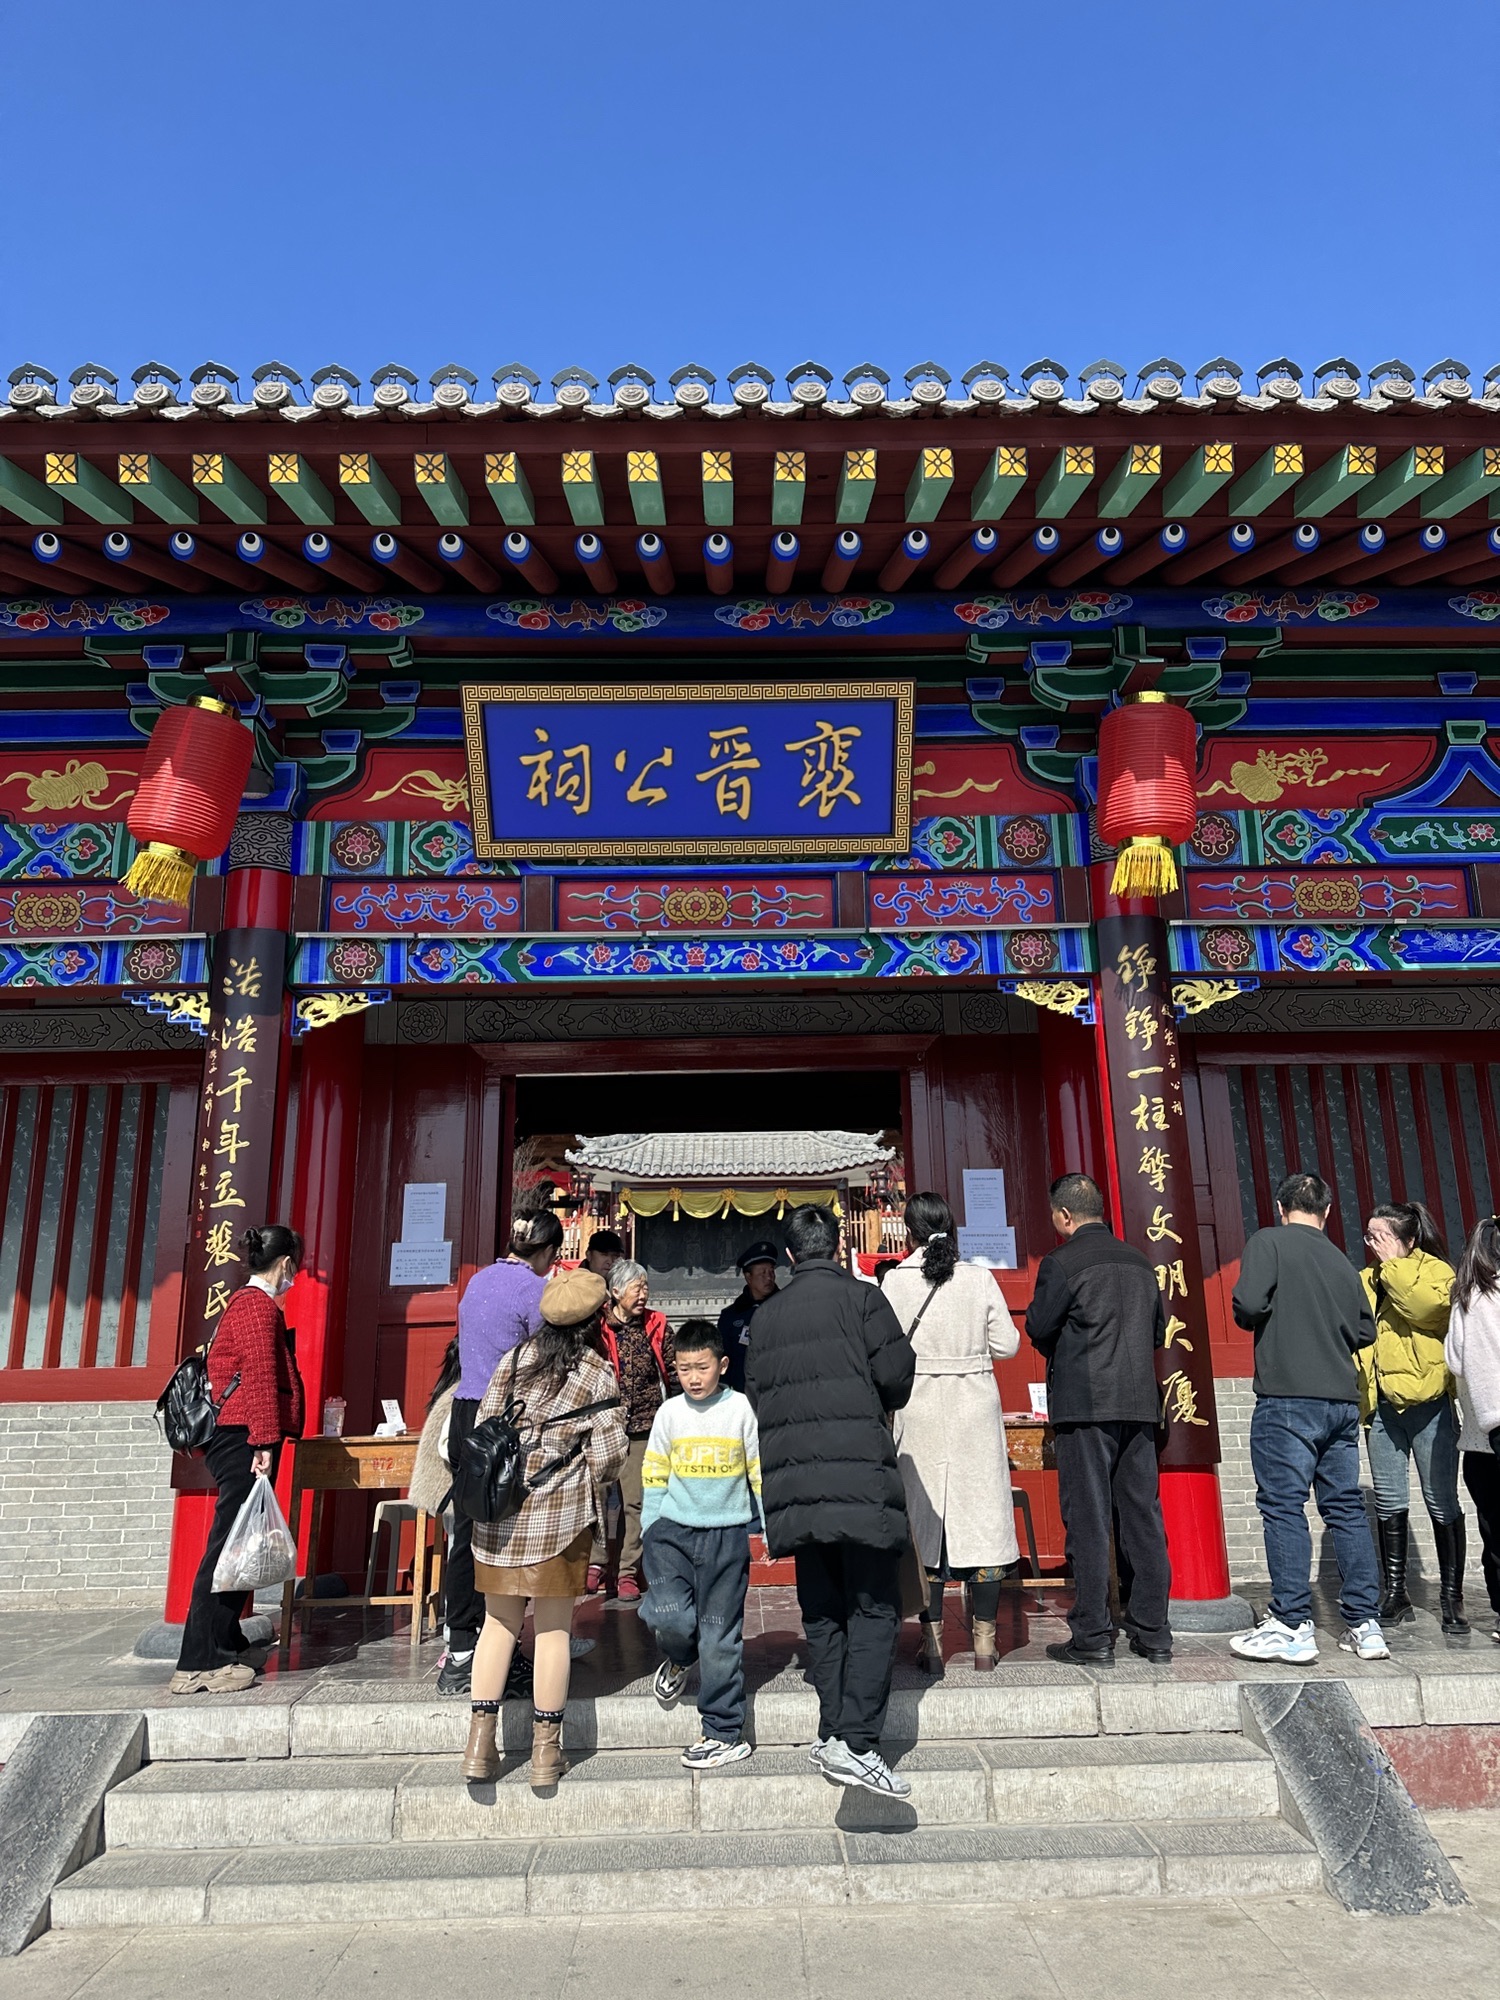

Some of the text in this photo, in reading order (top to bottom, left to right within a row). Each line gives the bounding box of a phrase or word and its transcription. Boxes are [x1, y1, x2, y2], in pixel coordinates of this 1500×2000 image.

[196, 956, 262, 1354] 浩浩千年立裴氏
